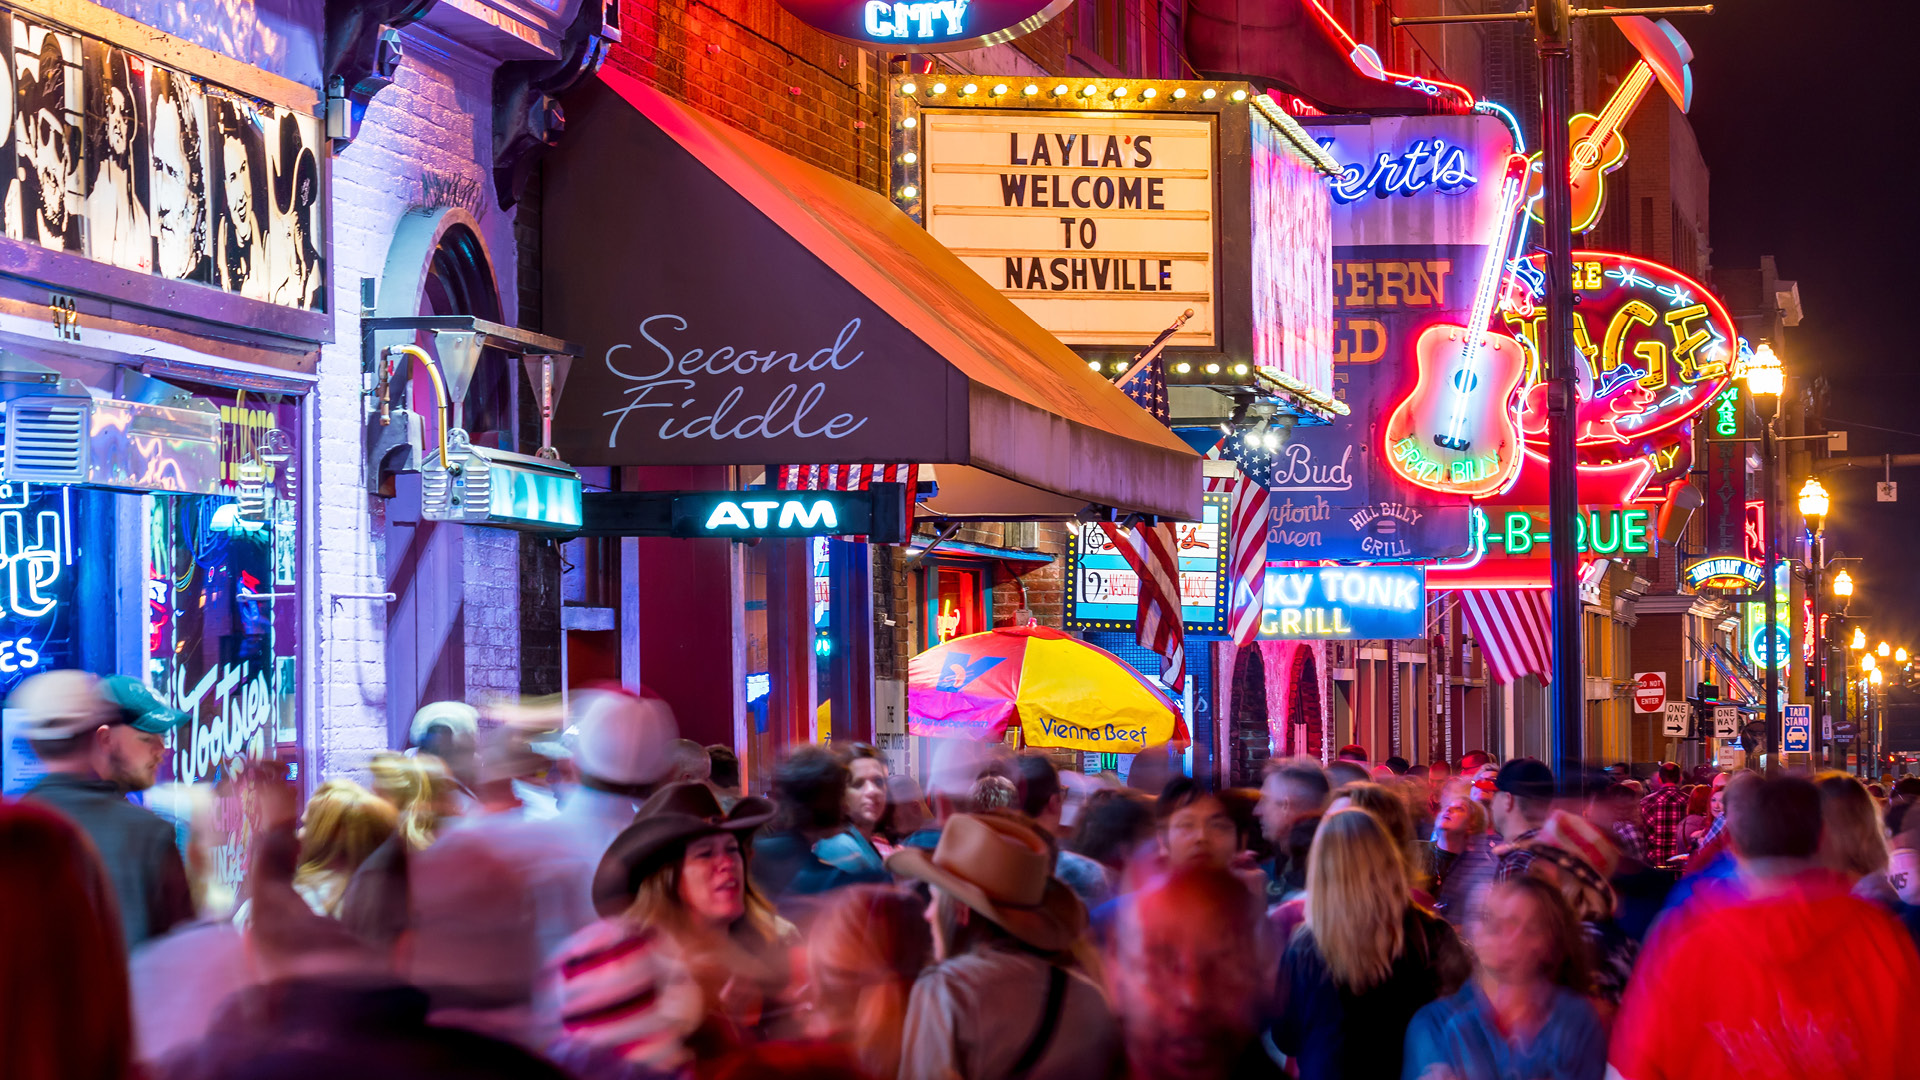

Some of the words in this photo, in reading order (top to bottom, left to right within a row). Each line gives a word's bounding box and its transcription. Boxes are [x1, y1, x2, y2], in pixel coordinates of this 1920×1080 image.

[865, 0, 970, 38] CITY
[1010, 132, 1152, 169] LAYLA'S
[1316, 137, 1478, 204] ert's
[1000, 173, 1165, 210] WELCOME
[1060, 217, 1097, 250] TO
[1005, 256, 1173, 291] NASHVILLE
[605, 313, 865, 381] Second
[602, 378, 869, 449] Fiddle
[1275, 443, 1353, 486] Bud
[705, 500, 838, 530] ATM
[1349, 506, 1380, 531] HILL
[1380, 502, 1424, 526] BILLY
[1361, 536, 1411, 557] GRILL
[1183, 575, 1209, 598] MUSIC
[1743, 563, 1761, 582] BAR
[1319, 570, 1420, 610] TONK
[1260, 606, 1351, 636] GRILL
[1666, 714, 1686, 723] WAY
[1668, 704, 1686, 713] ONE
[1716, 718, 1736, 726] WAY
[1717, 709, 1735, 717] ONE
[1785, 716, 1809, 727] STAND
[1789, 707, 1806, 717] TAXI
[1039, 717, 1101, 741] Vienna
[1104, 724, 1148, 748] Beef
